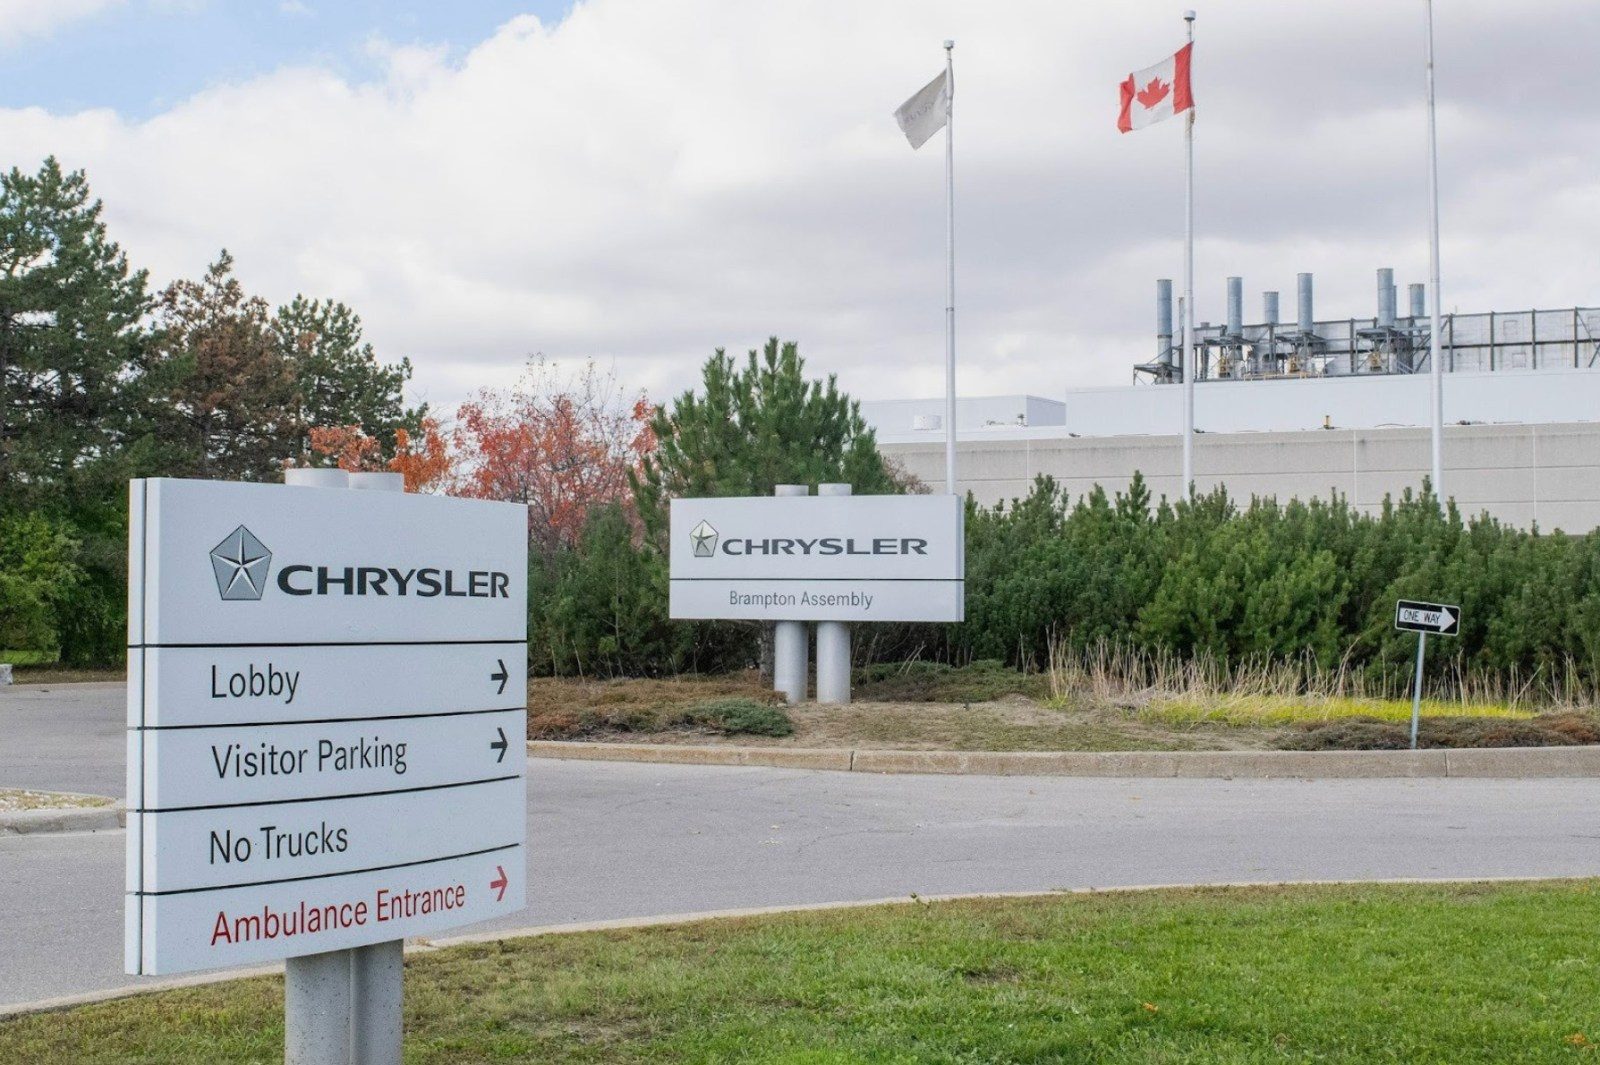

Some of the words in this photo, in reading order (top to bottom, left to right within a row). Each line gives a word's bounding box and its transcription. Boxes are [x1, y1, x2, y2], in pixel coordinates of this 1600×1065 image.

[721, 538, 928, 555] CHRYSLER
[277, 564, 510, 599] CHRYSLER
[729, 590, 796, 609] Brampton
[800, 591, 873, 610] Assembly
[1403, 609, 1419, 622] ONE
[1424, 613, 1440, 624] WAY
[211, 663, 300, 704] Lobby
[211, 743, 308, 779] Visitor
[318, 735, 408, 774] Parking
[209, 829, 252, 865] No
[260, 821, 349, 861] Trucks
[211, 899, 368, 946] Ambulance
[376, 882, 466, 922] Entrance
